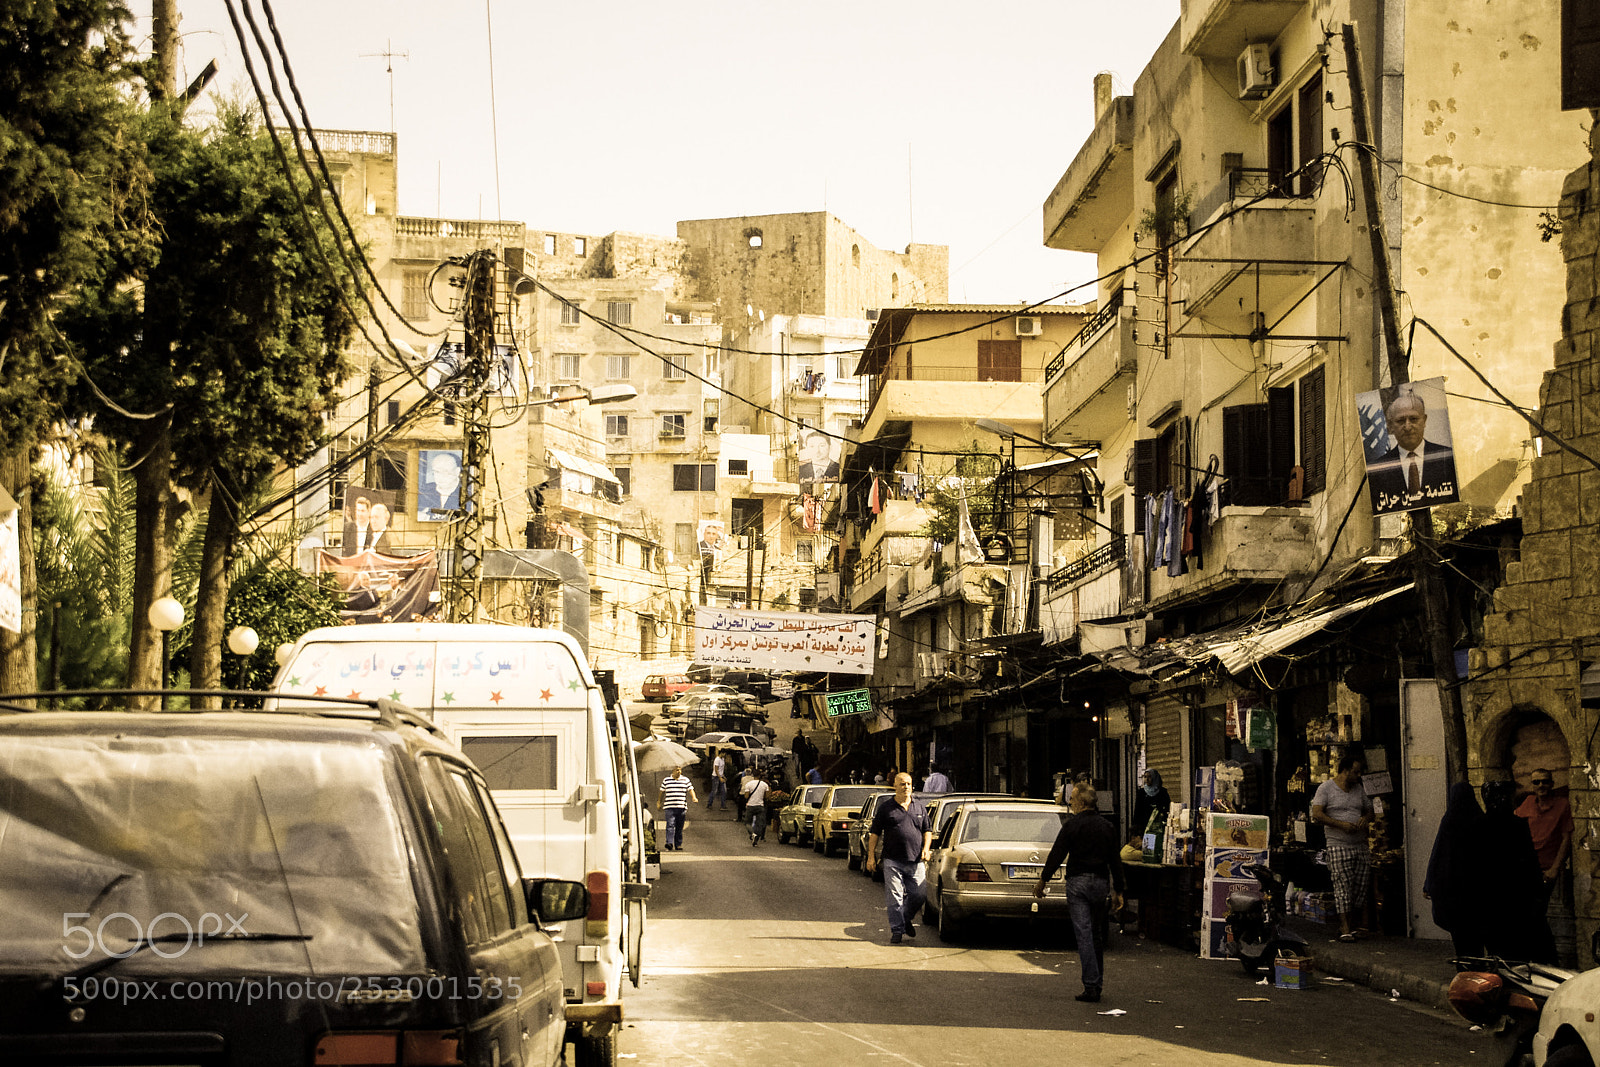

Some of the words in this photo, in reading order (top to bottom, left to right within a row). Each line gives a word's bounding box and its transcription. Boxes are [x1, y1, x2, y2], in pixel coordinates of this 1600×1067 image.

[1401, 490, 1425, 506] حسين
[1425, 482, 1453, 498] تقدمة
[1376, 491, 1400, 511] حراش
[712, 614, 748, 630] الحراش
[750, 618, 775, 631] حسين
[778, 619, 805, 633] للبطل
[807, 620, 836, 636] مبروك
[701, 634, 718, 649] أول
[719, 635, 749, 651] بمركز
[751, 636, 779, 651] تونس
[780, 638, 809, 653] العرب
[811, 638, 839, 655] بطولة
[841, 640, 866, 657] بفوزه
[340, 653, 384, 678] ماوس
[390, 651, 434, 680] ميكي
[440, 651, 484, 678] كريم
